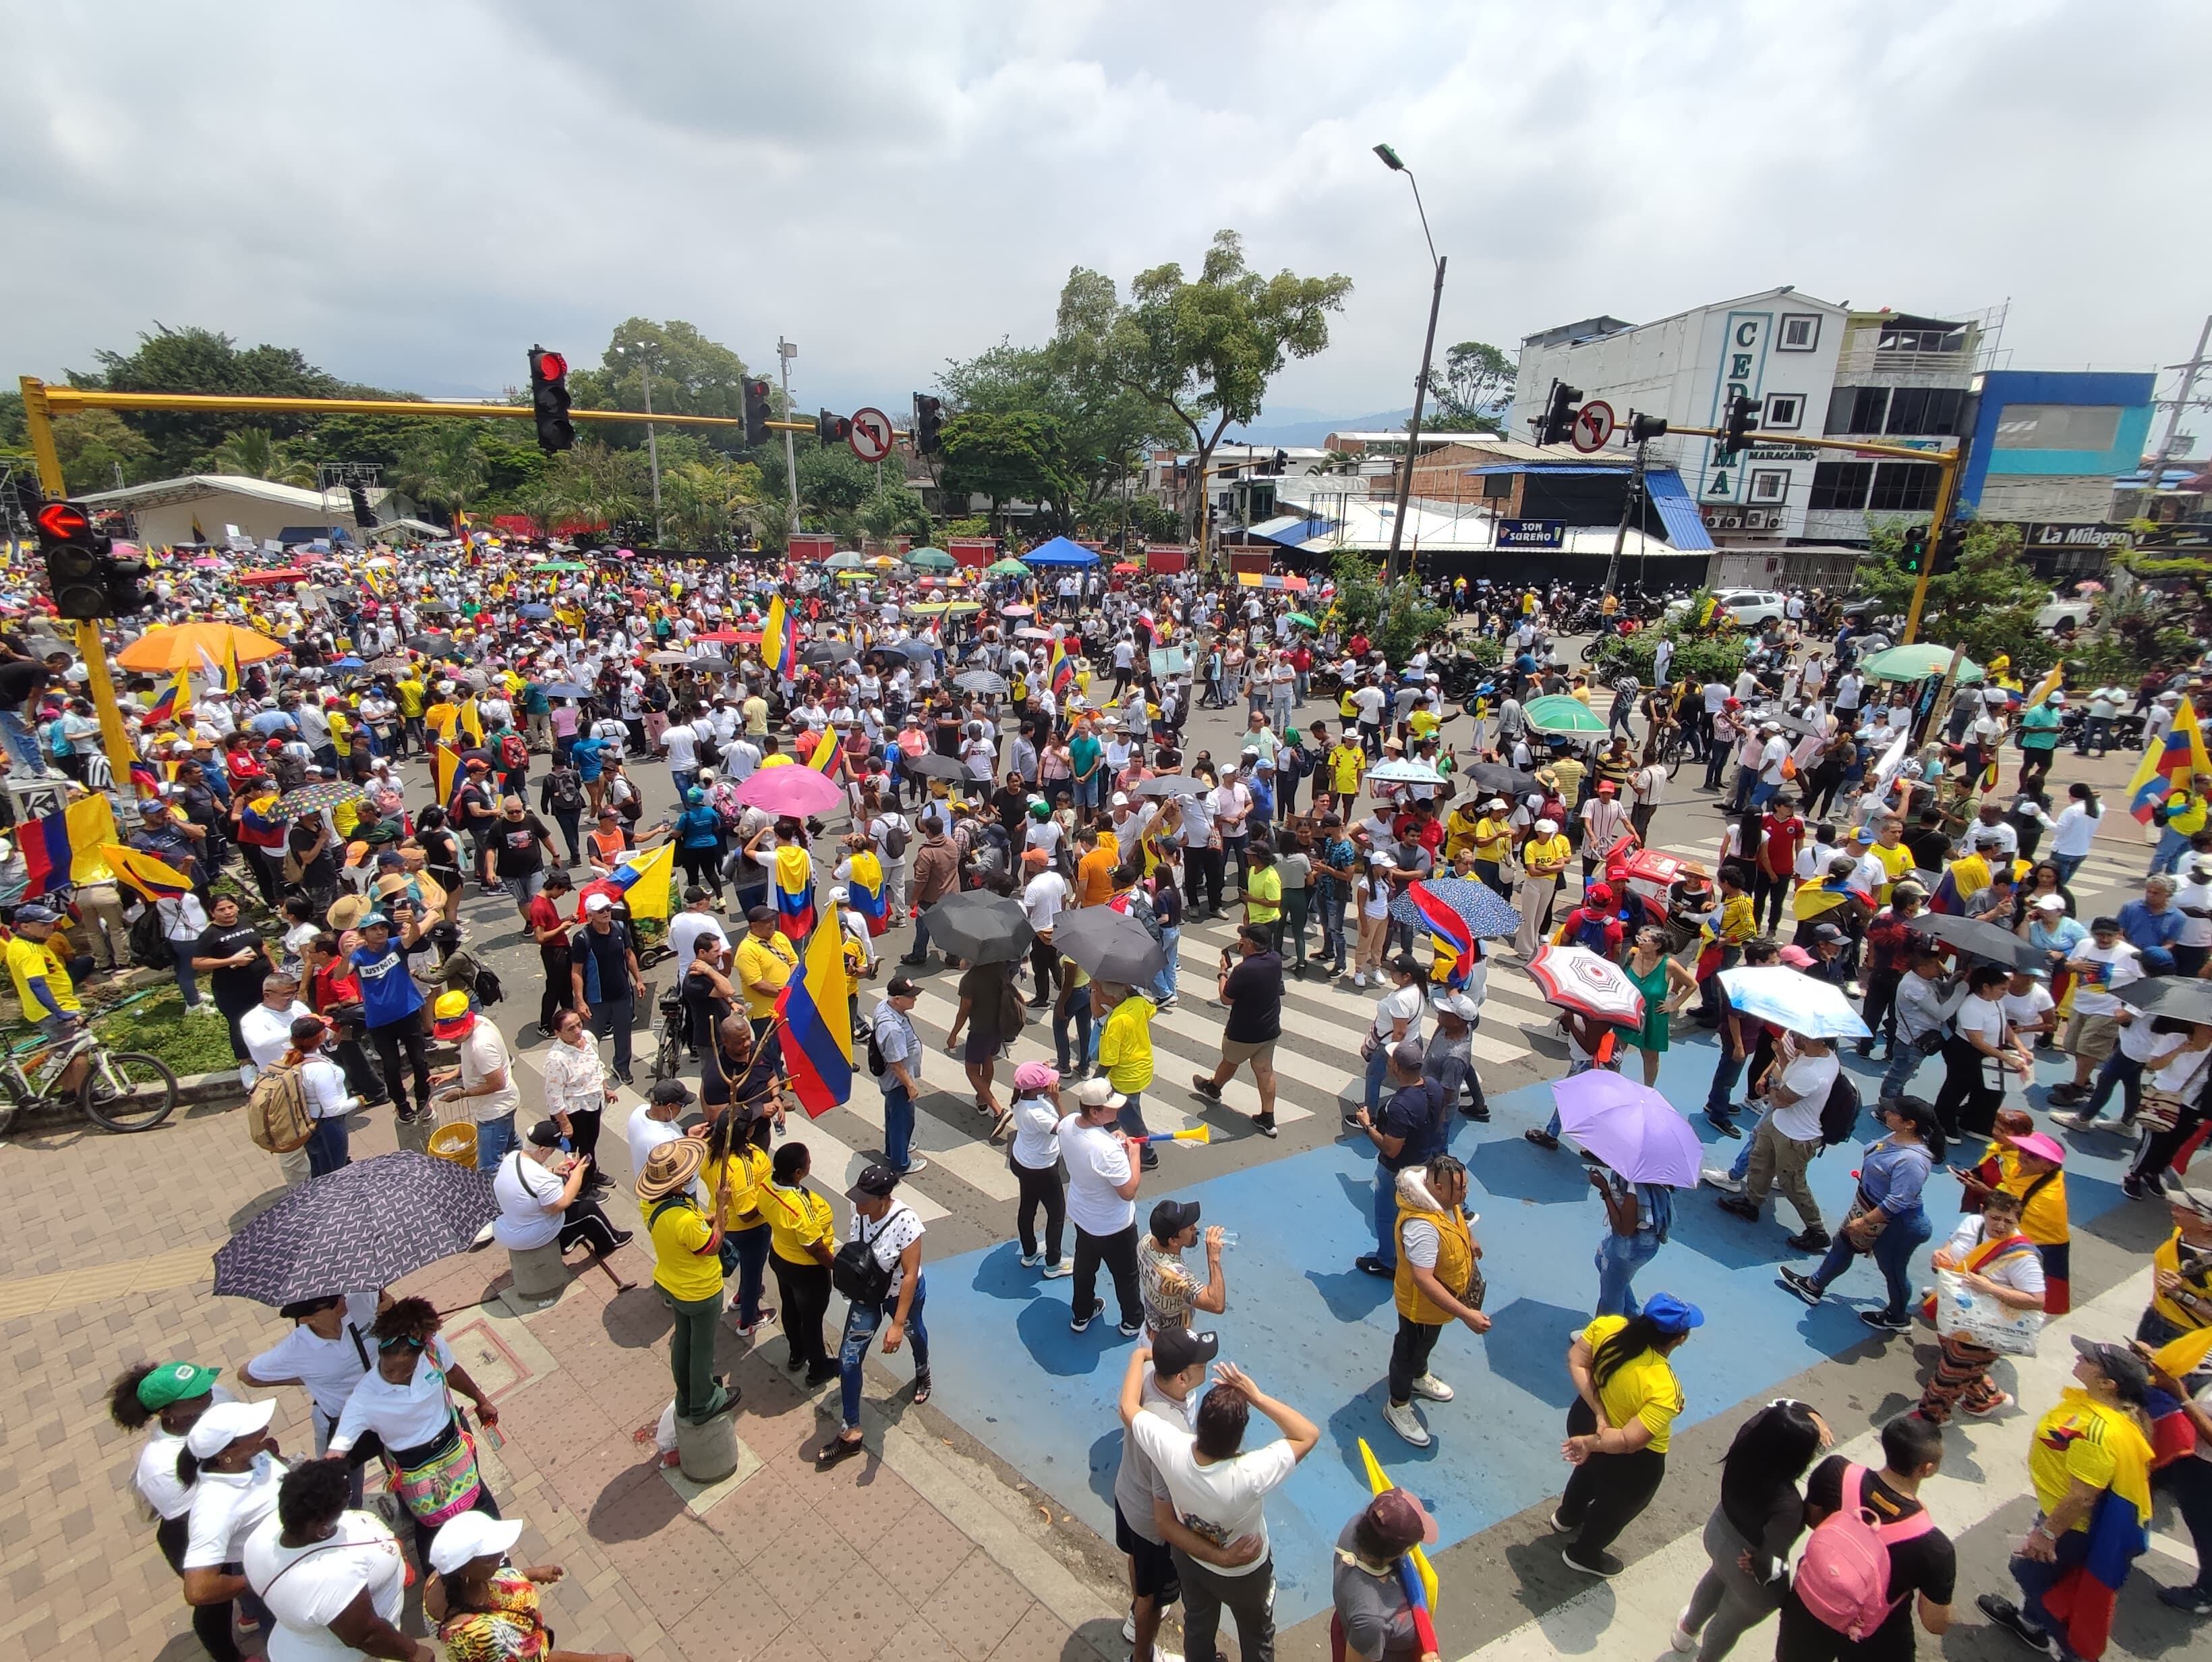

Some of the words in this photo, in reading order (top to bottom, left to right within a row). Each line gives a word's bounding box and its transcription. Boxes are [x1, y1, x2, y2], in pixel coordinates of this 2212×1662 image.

[1708, 322, 1758, 494] CEDMA
[1748, 451, 1816, 461] MARACAIBO
[1521, 523, 1543, 532] SON
[1509, 532, 1551, 542] SUREÑO
[2039, 525, 2062, 544] La
[364, 967, 380, 975] JUST
[1979, 1321, 2029, 1336] HOMECENTER
